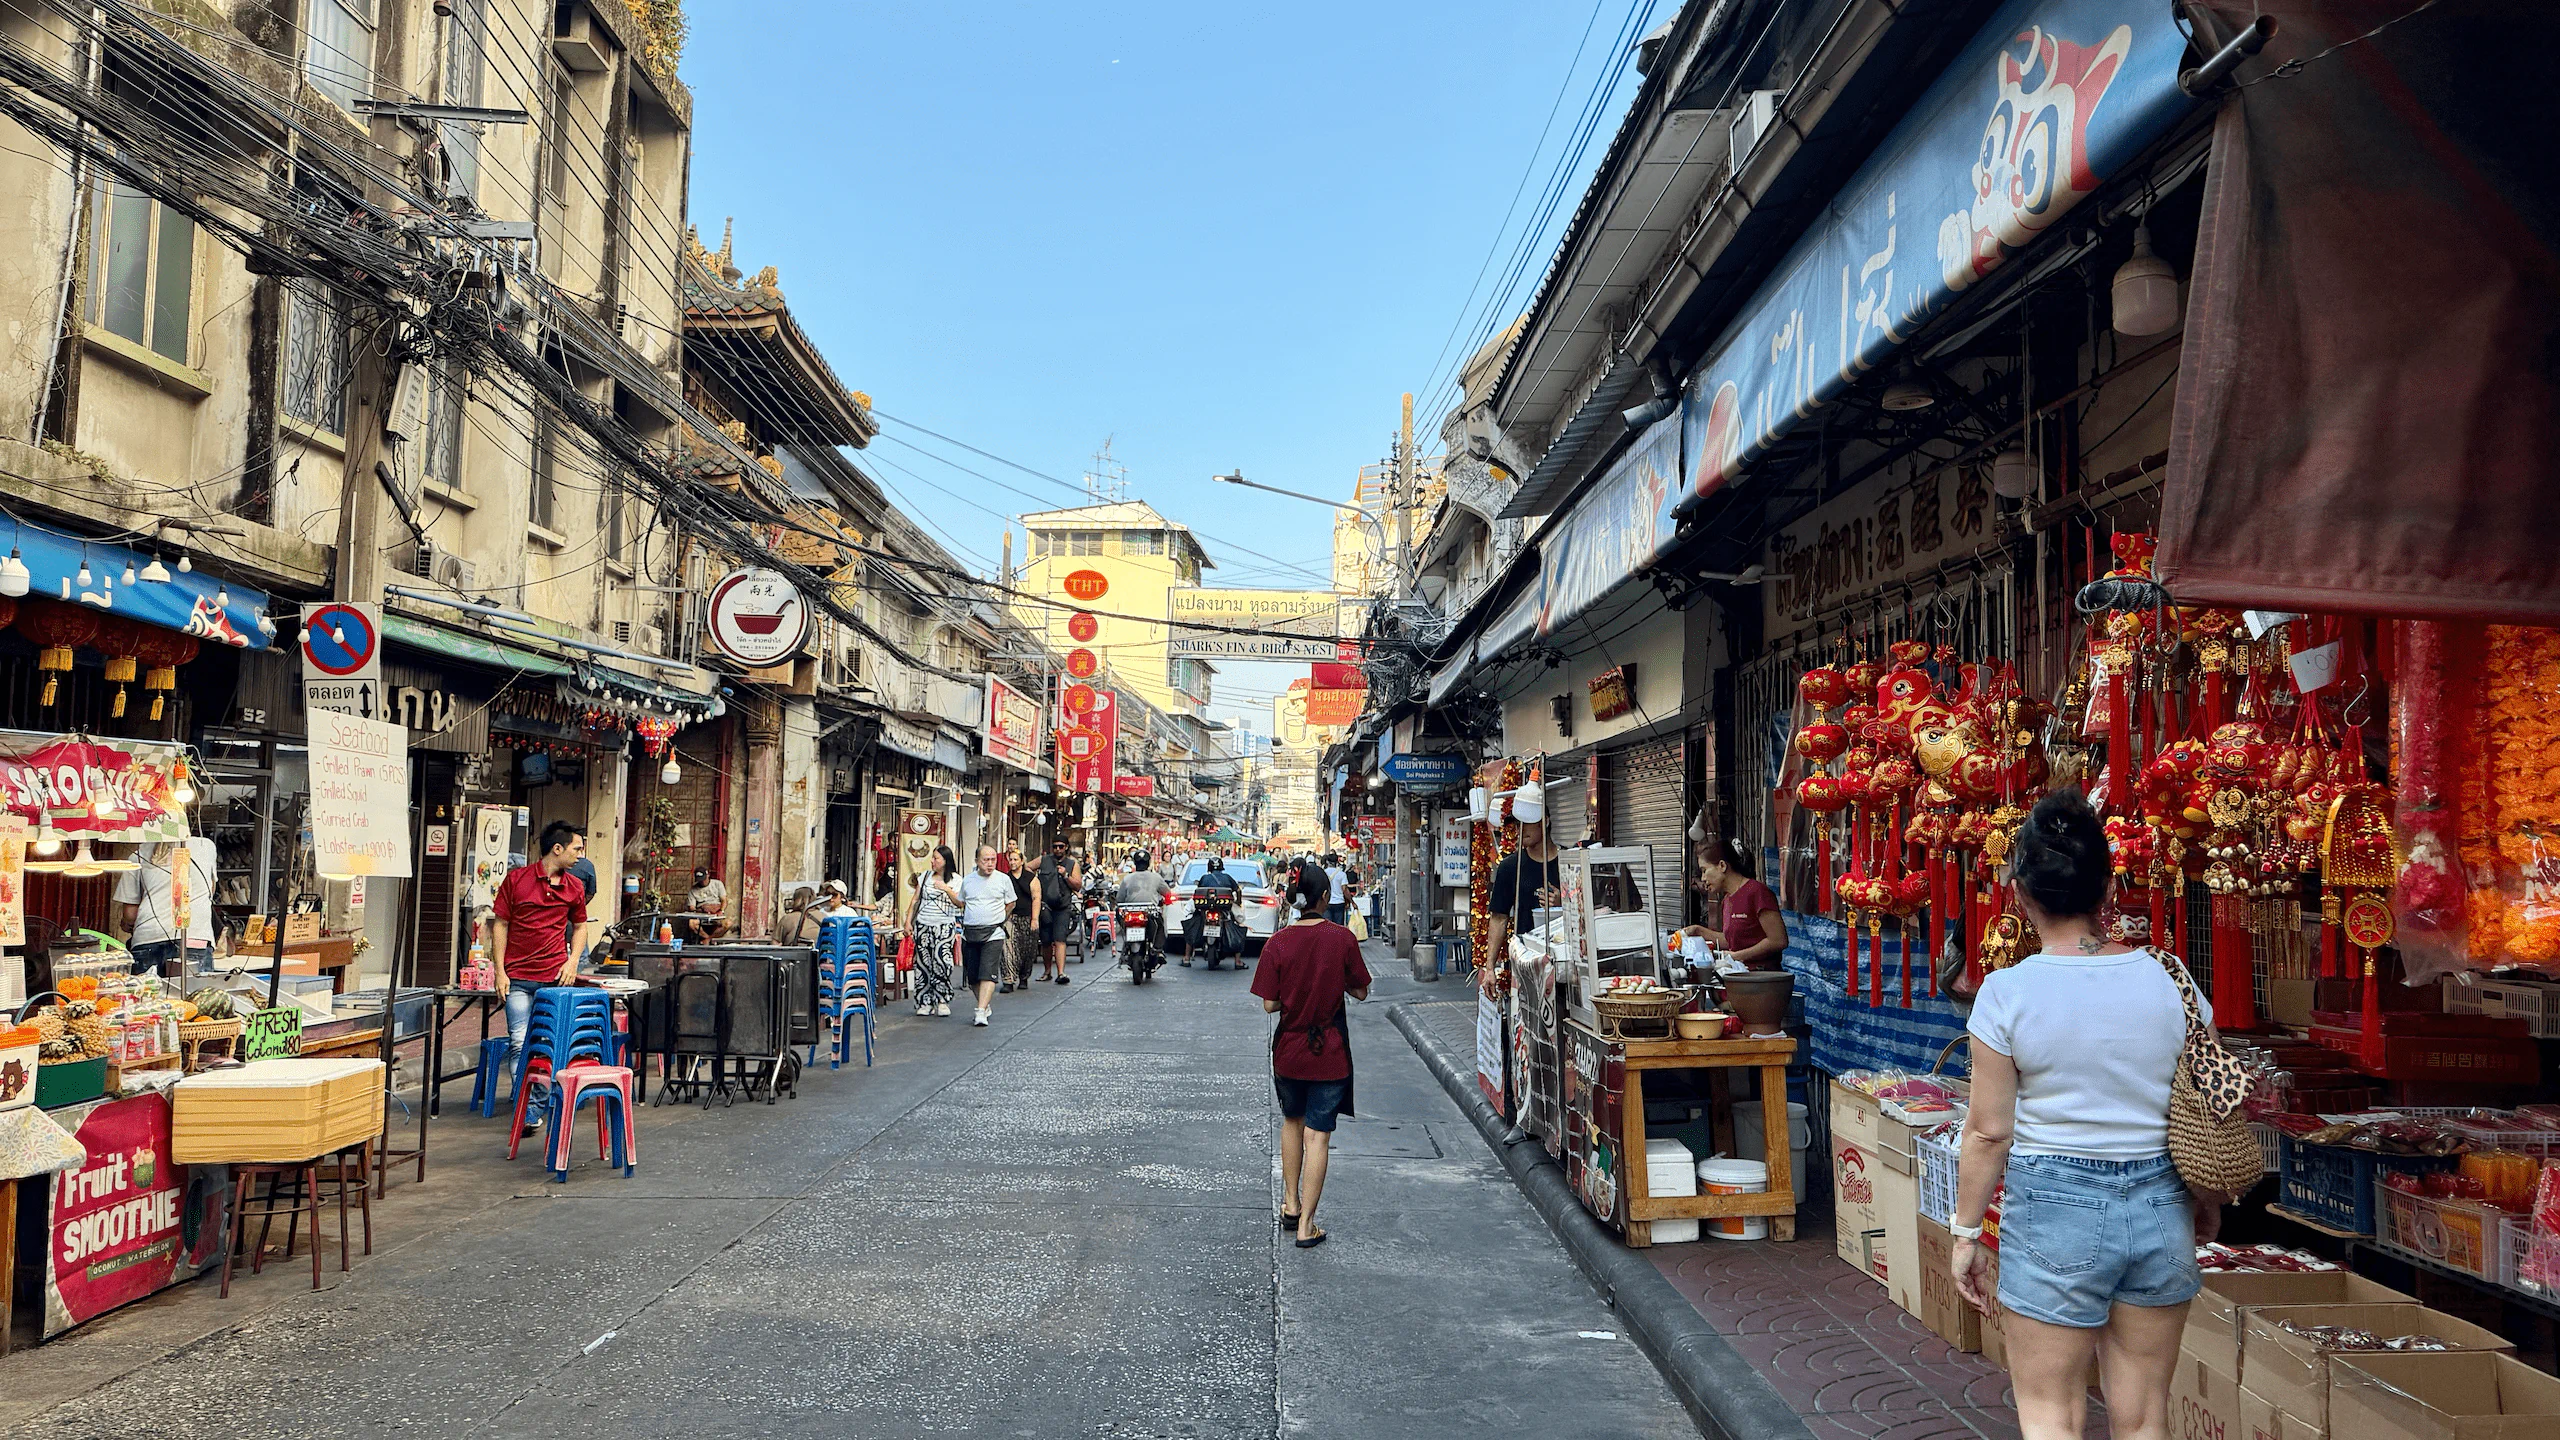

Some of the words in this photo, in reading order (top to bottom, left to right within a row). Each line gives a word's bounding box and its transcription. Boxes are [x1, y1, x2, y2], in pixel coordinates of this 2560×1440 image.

[1070, 578, 1103, 592] THT
[1176, 594, 1243, 611] แปลงนาม
[1174, 640, 1223, 653] SHARK'S
[1226, 641, 1246, 653] FIN
[1249, 642, 1258, 653] &
[1303, 644, 1334, 656] NEST
[309, 686, 354, 699] ตลอด
[243, 707, 266, 724] 52
[329, 715, 389, 755] Seafood
[322, 754, 349, 776] Grilled
[353, 756, 376, 779] Prawn
[1395, 757, 1447, 770] ซอยพิพากษา
[1405, 771, 1415, 779] Soi
[1415, 771, 1441, 780] Phiphaksa
[320, 780, 346, 800] Grilled
[347, 782, 368, 805] Squid
[321, 810, 351, 828] Curried
[352, 812, 370, 828] Crab
[323, 836, 357, 855] Lobster
[492, 860, 505, 876] 40
[255, 1009, 299, 1038] FRESH
[64, 1152, 128, 1209] Fruit
[63, 1187, 181, 1264] SMOOTHIE
[1925, 1264, 1950, 1311] A703
